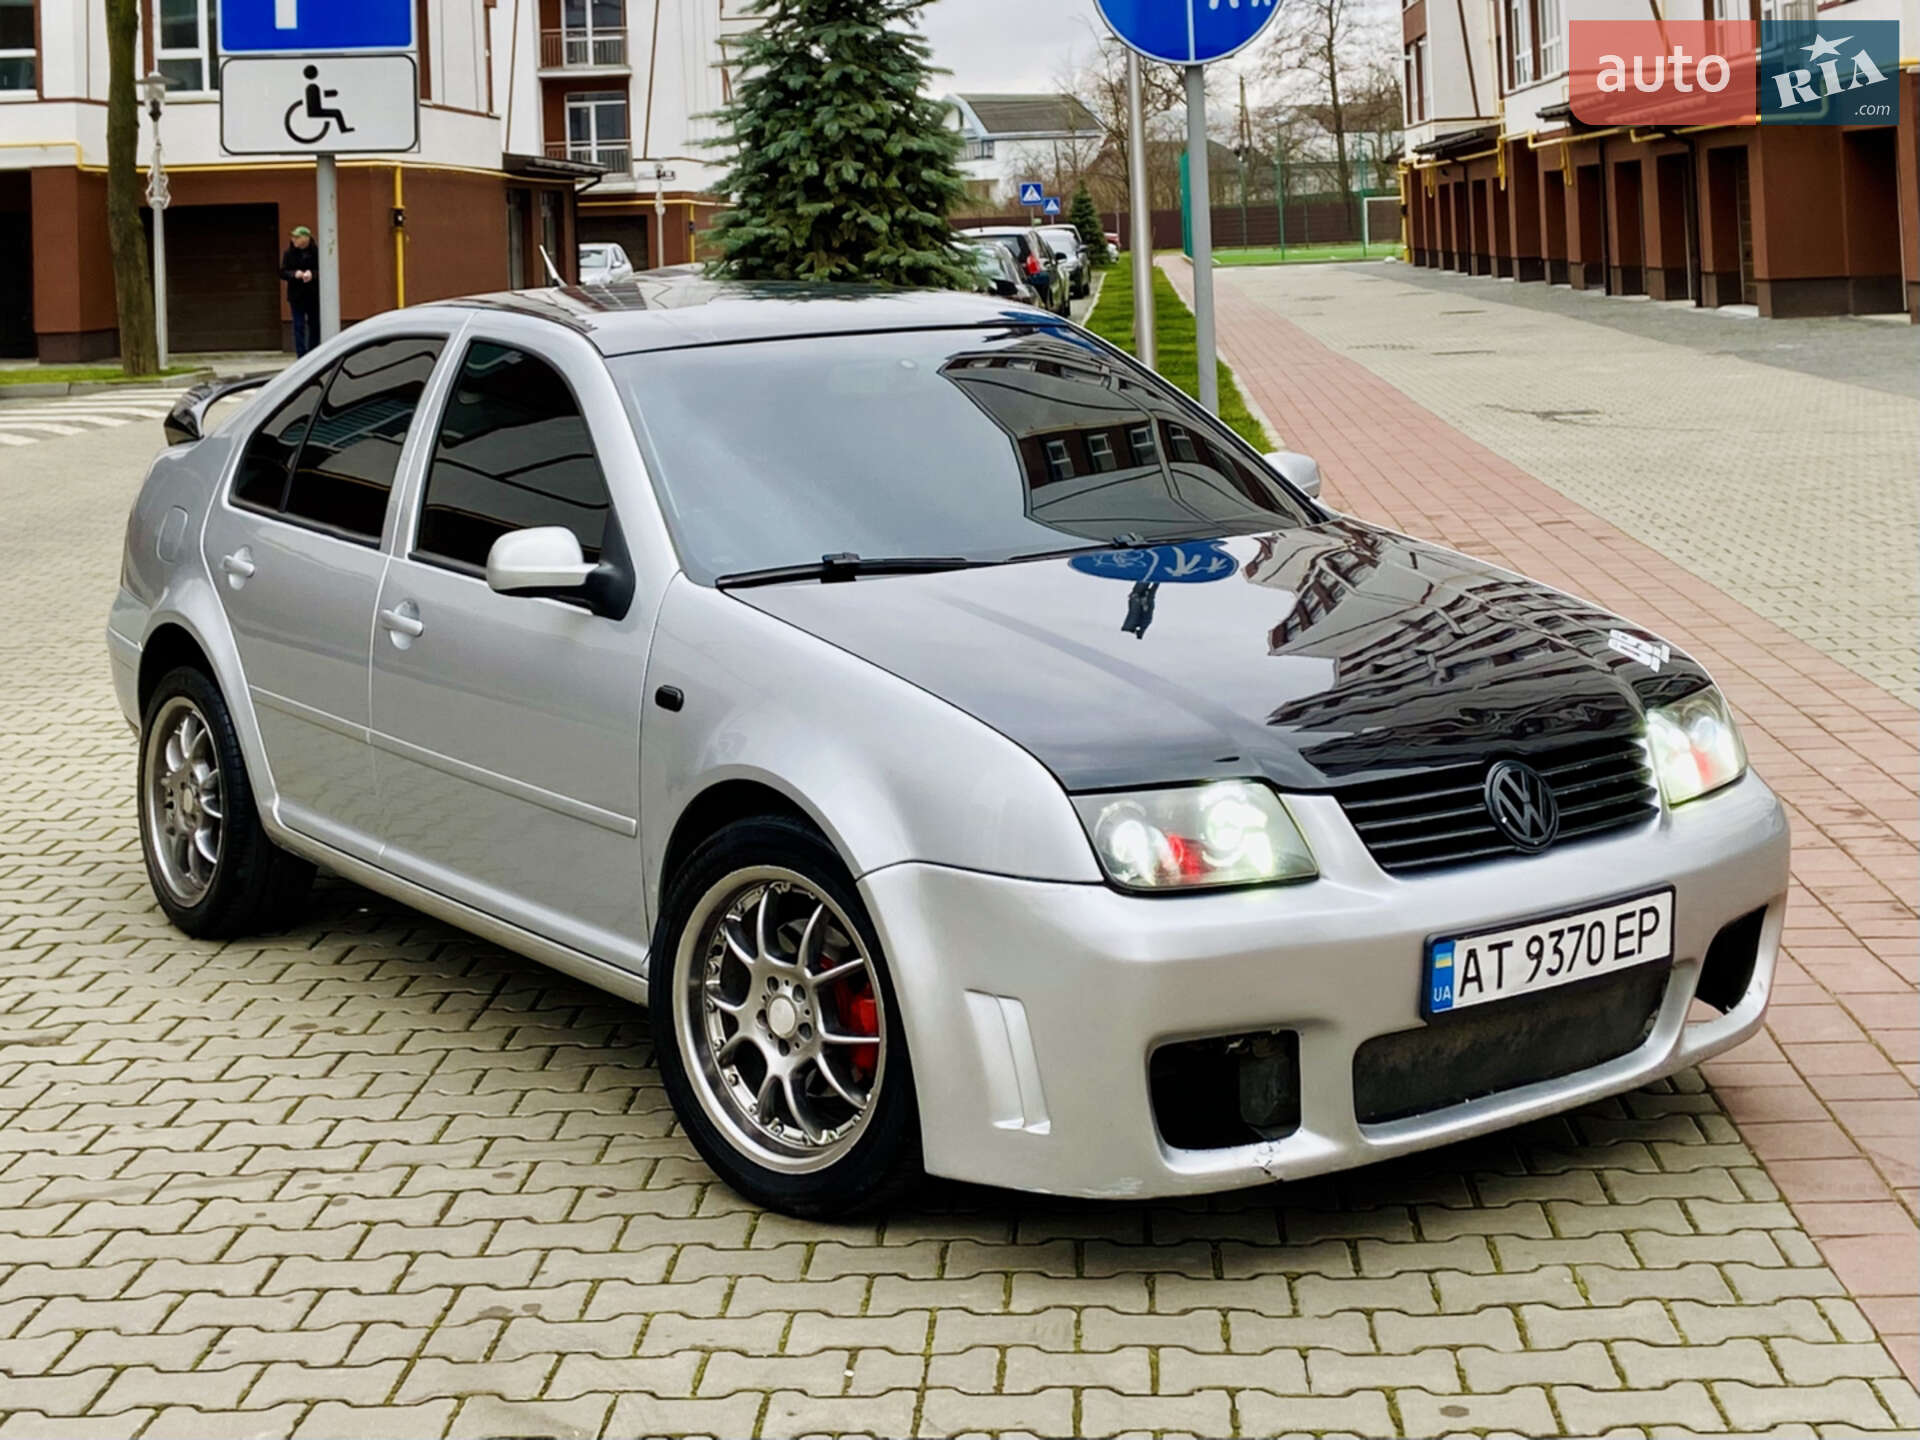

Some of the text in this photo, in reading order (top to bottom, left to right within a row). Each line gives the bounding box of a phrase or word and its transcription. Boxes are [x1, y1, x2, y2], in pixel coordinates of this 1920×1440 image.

[1459, 906, 1660, 997] AT 9370 EP
[1434, 985, 1452, 1002] UA
